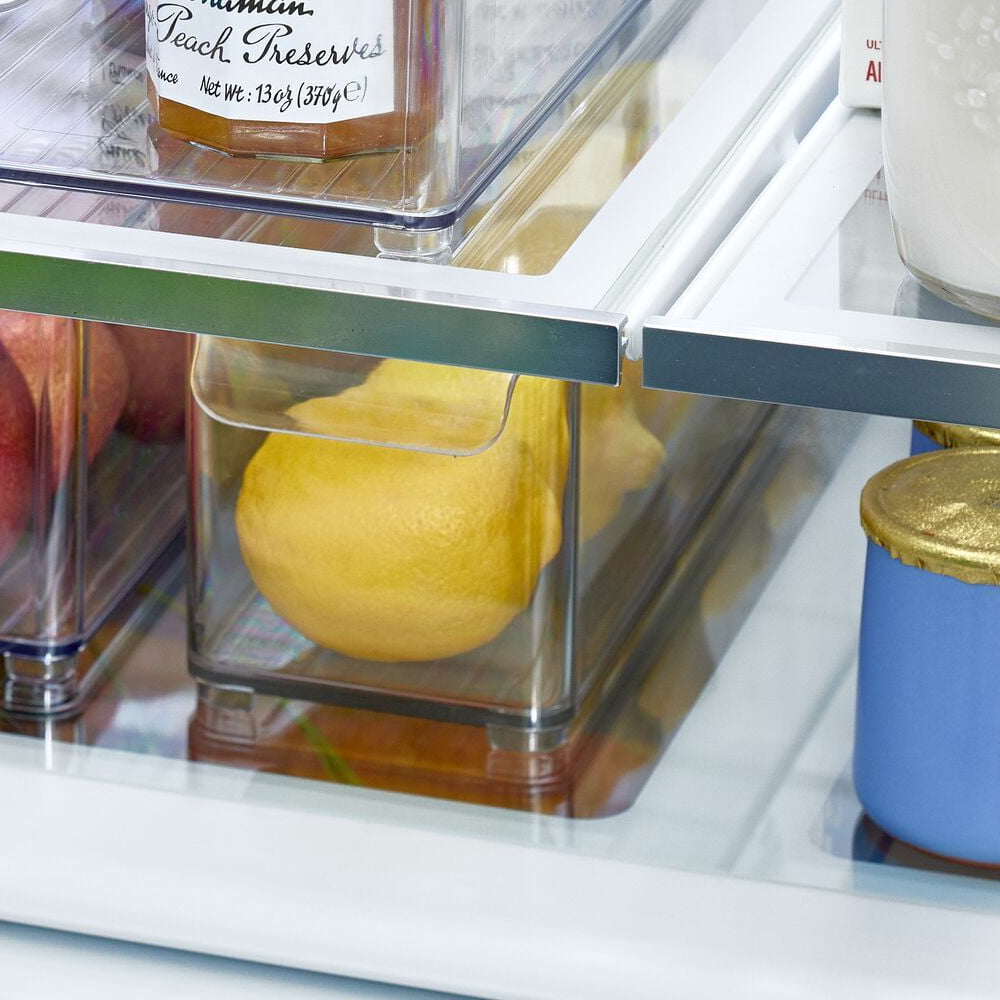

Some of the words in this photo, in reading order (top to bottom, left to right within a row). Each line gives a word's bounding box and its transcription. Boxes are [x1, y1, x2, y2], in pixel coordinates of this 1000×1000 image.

[156, 2, 231, 64] Peach
[242, 22, 384, 67] Preserves
[200, 74, 221, 98] Net
